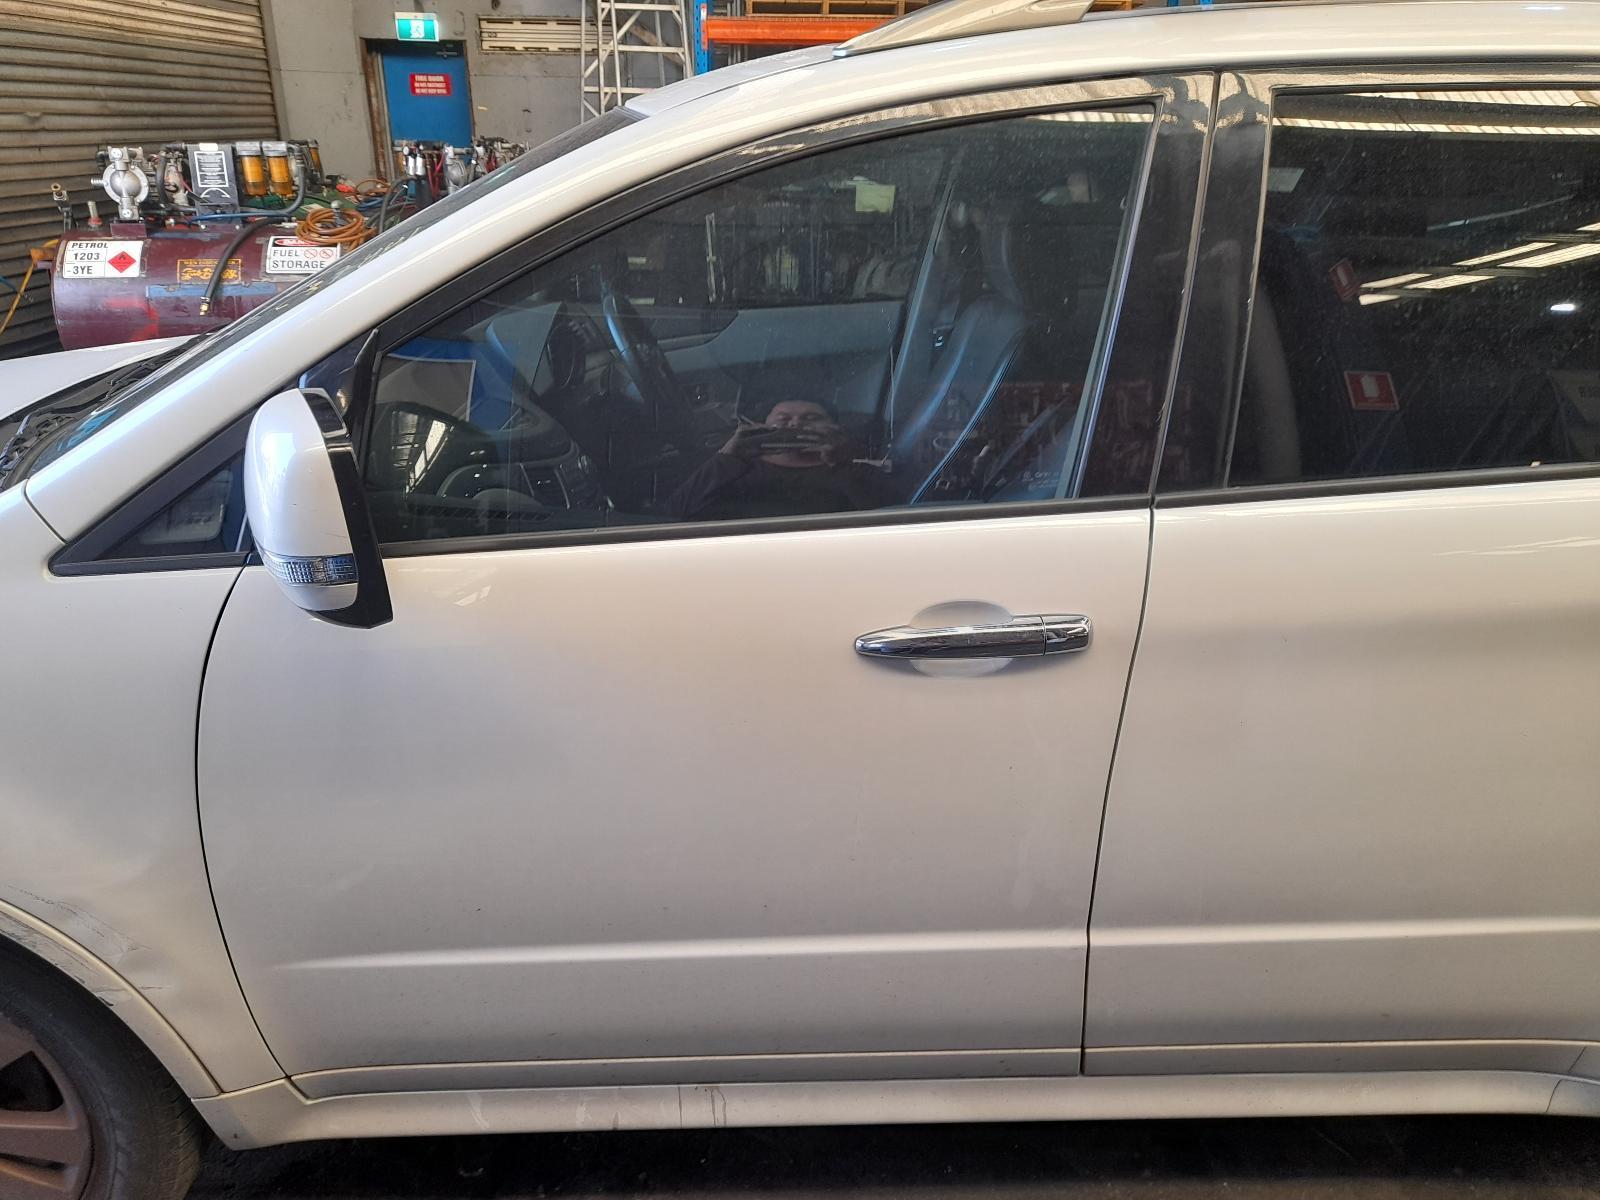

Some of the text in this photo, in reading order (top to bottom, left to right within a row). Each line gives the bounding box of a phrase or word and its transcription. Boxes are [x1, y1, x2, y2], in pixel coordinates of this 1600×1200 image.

[73, 252, 100, 261] 1203
[272, 249, 299, 257] FUEL
[272, 260, 326, 269] STORAGE
